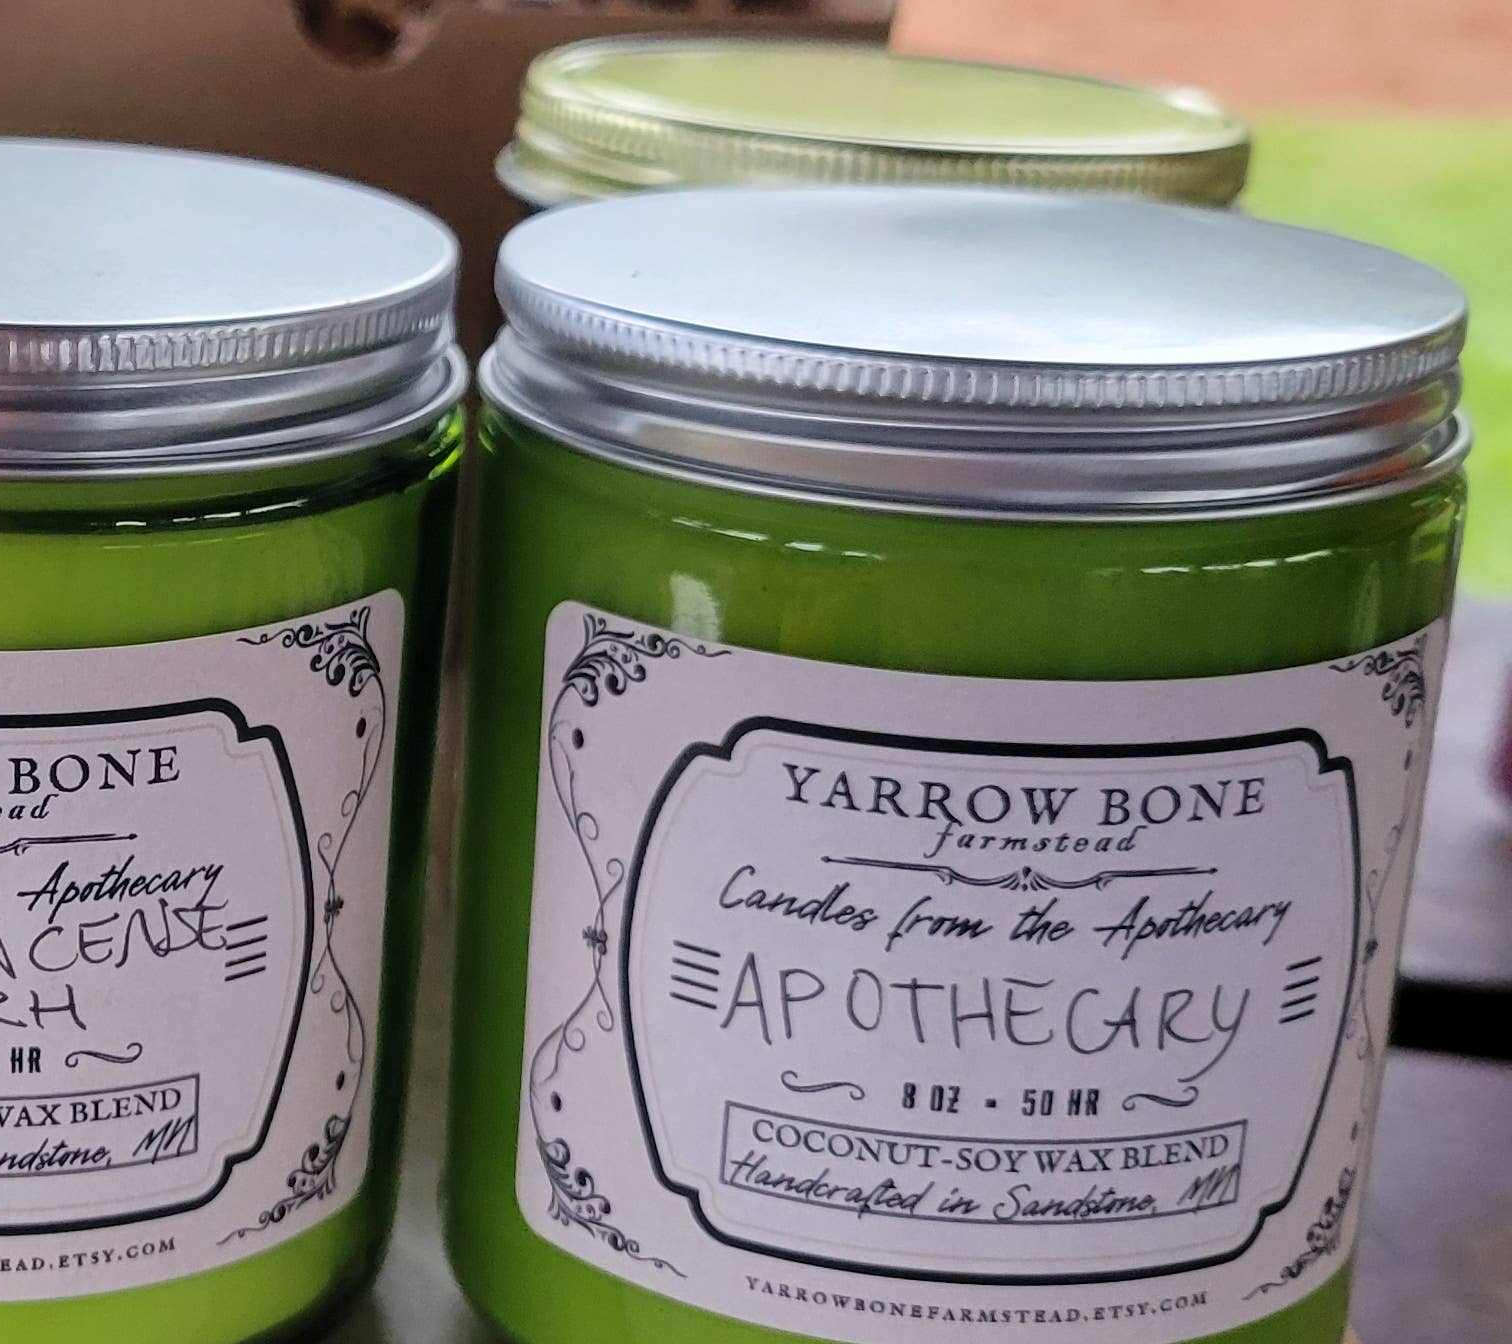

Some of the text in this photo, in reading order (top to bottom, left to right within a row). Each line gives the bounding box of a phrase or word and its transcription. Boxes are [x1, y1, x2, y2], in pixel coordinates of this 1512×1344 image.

[10, 746, 182, 794] BONE
[780, 763, 1266, 828] YARROW BONE
[924, 819, 1141, 858] farmstead
[18, 858, 225, 920] Apothecary
[719, 864, 1293, 962] Candles from the Apothecary
[720, 952, 1251, 1084] APOTHECARY
[10, 1047, 43, 1073] HR
[70, 1087, 182, 1125] BLEND
[902, 1085, 1100, 1116] 8 OZ 50 HR
[751, 1118, 1231, 1174] COCONUT-SOY WAX BLEND
[729, 1153, 934, 1220] Handcrafted
[938, 1190, 979, 1216] in
[746, 1274, 1209, 1325] YARROWBONEFARMSTEAD.ETSY.COM
